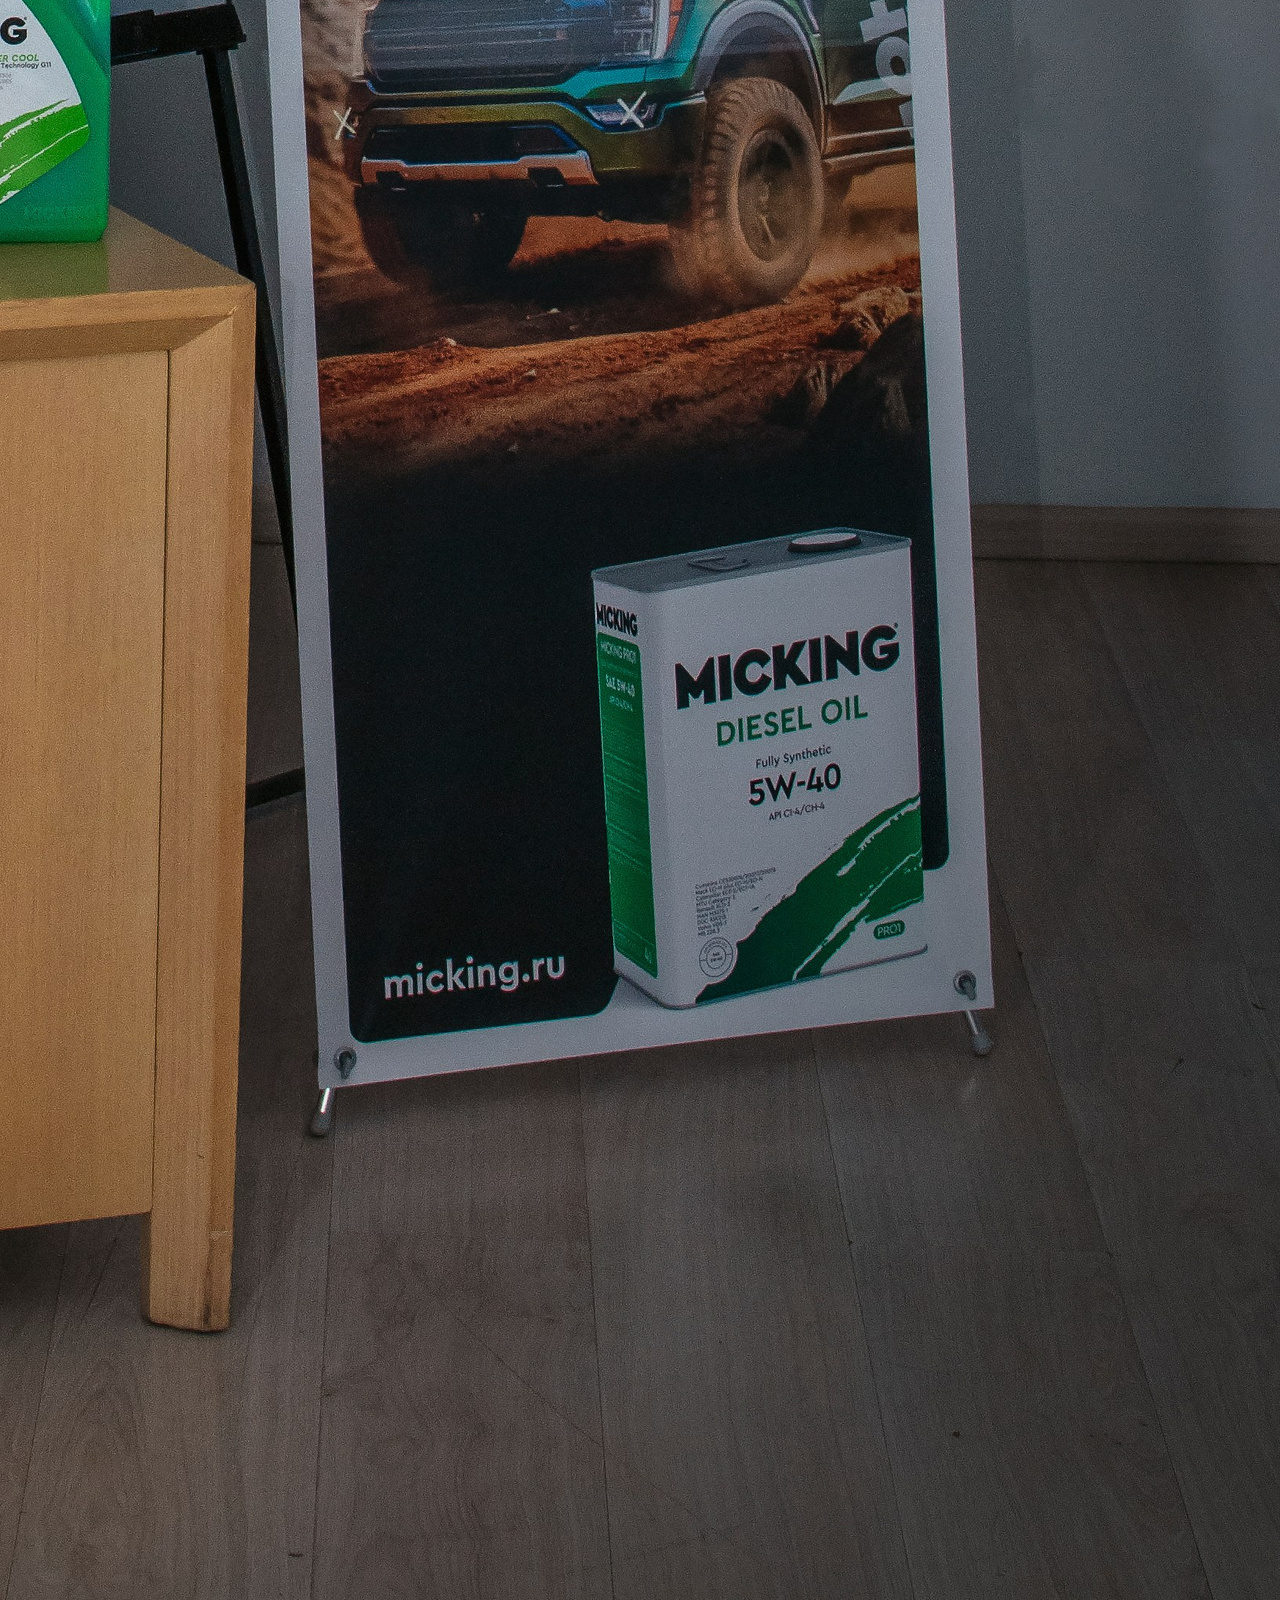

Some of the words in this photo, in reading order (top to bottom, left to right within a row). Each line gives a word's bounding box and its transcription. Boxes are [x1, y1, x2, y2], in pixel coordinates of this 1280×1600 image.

[1, 62, 38, 71] Technology
[12, 53, 39, 62] COOL
[596, 602, 639, 637] MICKING
[675, 625, 900, 709] MICKING
[716, 705, 812, 747] DIESEL
[820, 695, 869, 726] OIL
[755, 752, 780, 769] Fully
[783, 744, 832, 764] Synthetic
[748, 763, 842, 806] 5W-40
[768, 809, 783, 821] API
[877, 922, 901, 936] PRO1
[384, 955, 565, 1000] micking.ru
